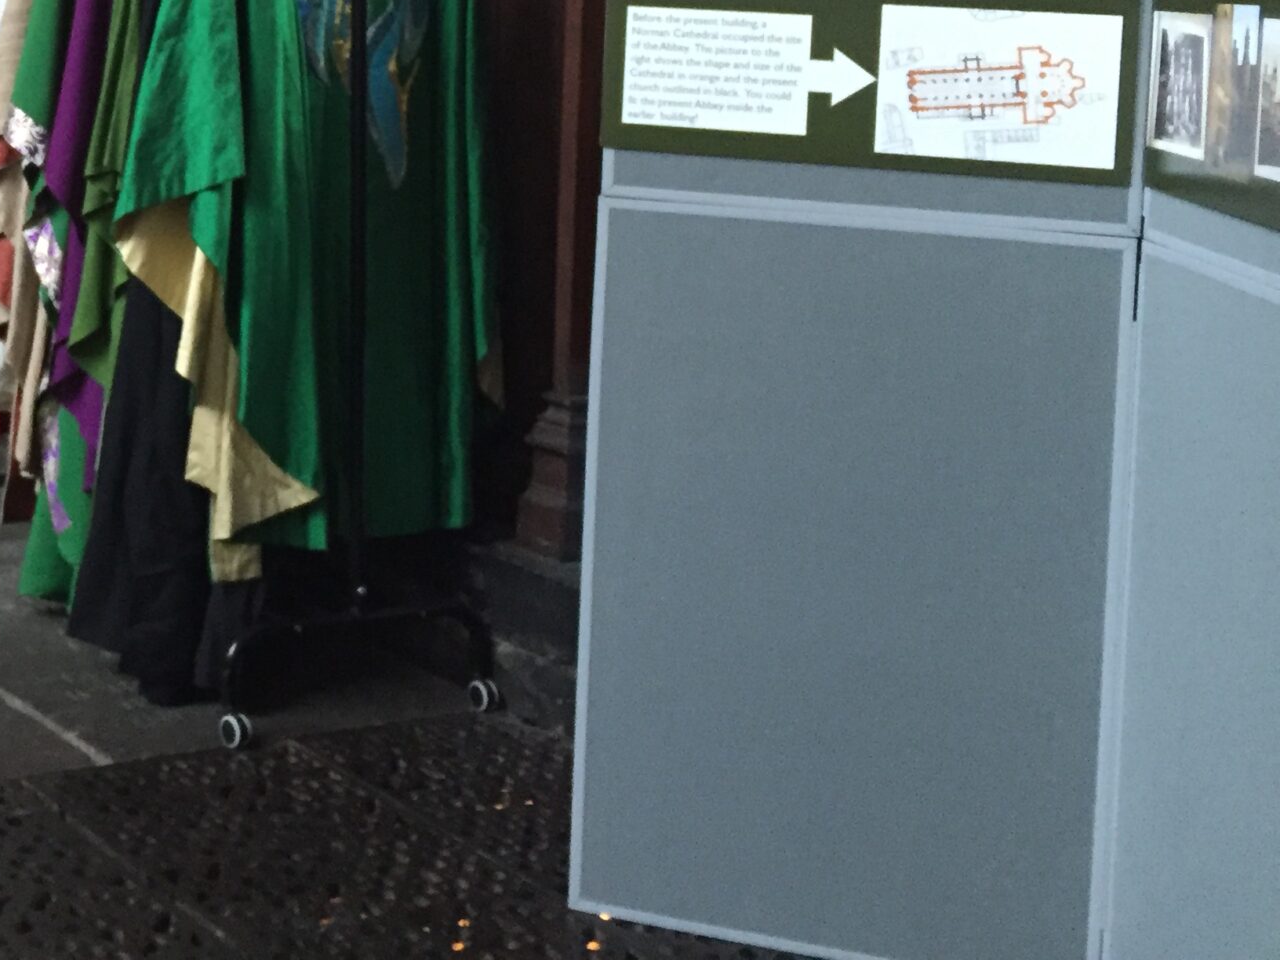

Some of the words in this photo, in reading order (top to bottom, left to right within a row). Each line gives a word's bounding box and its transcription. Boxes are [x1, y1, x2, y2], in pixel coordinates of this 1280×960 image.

[632, 27, 670, 37] Norman
[673, 28, 718, 40] Cathedral
[695, 43, 712, 52] The
[733, 61, 750, 70] and
[629, 68, 674, 79] Cathedral
[724, 74, 740, 82] and
[743, 75, 758, 83] the
